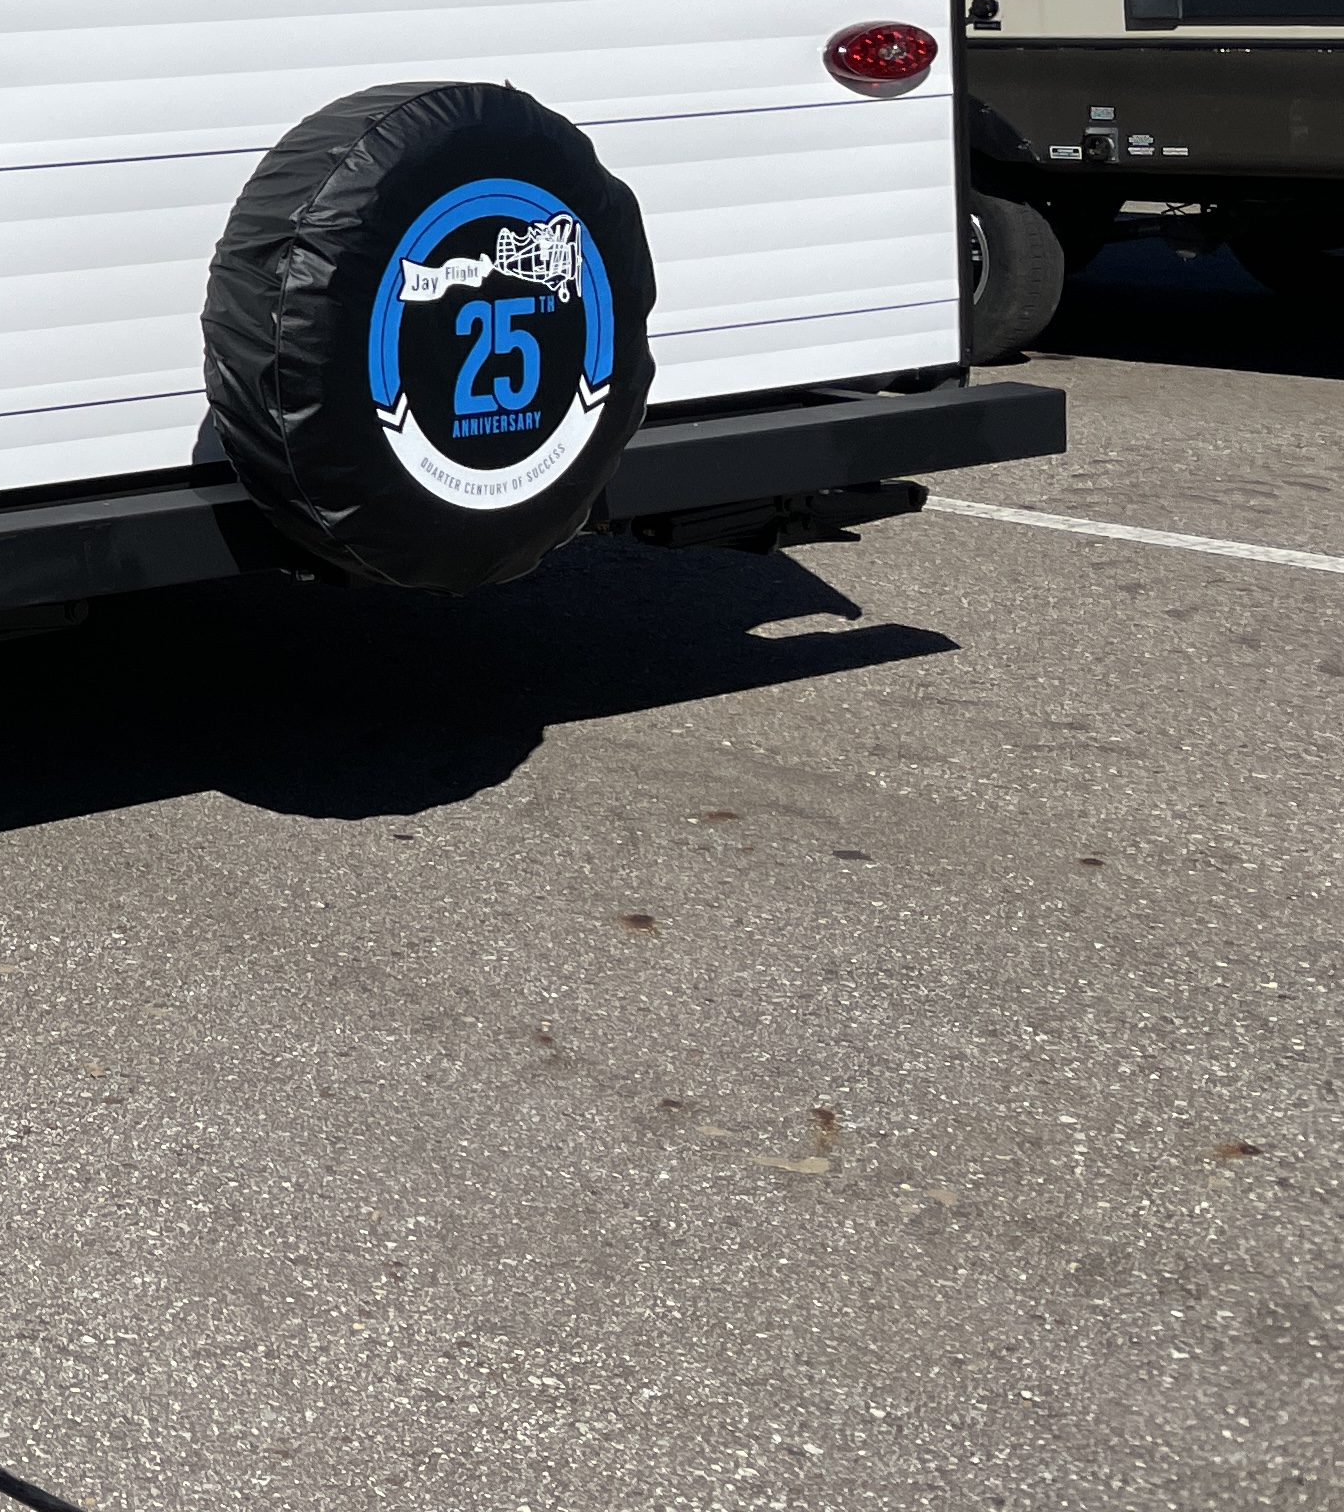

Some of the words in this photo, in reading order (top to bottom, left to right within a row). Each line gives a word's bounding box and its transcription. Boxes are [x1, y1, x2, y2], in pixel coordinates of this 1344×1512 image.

[411, 273, 439, 294] Jay
[444, 264, 479, 282] Flight
[451, 411, 541, 439] ANNIVERSARY
[419, 456, 462, 492] QUARTER
[464, 480, 509, 496] CENTURY
[511, 475, 524, 491] OF
[526, 442, 566, 484] SUCCESS
